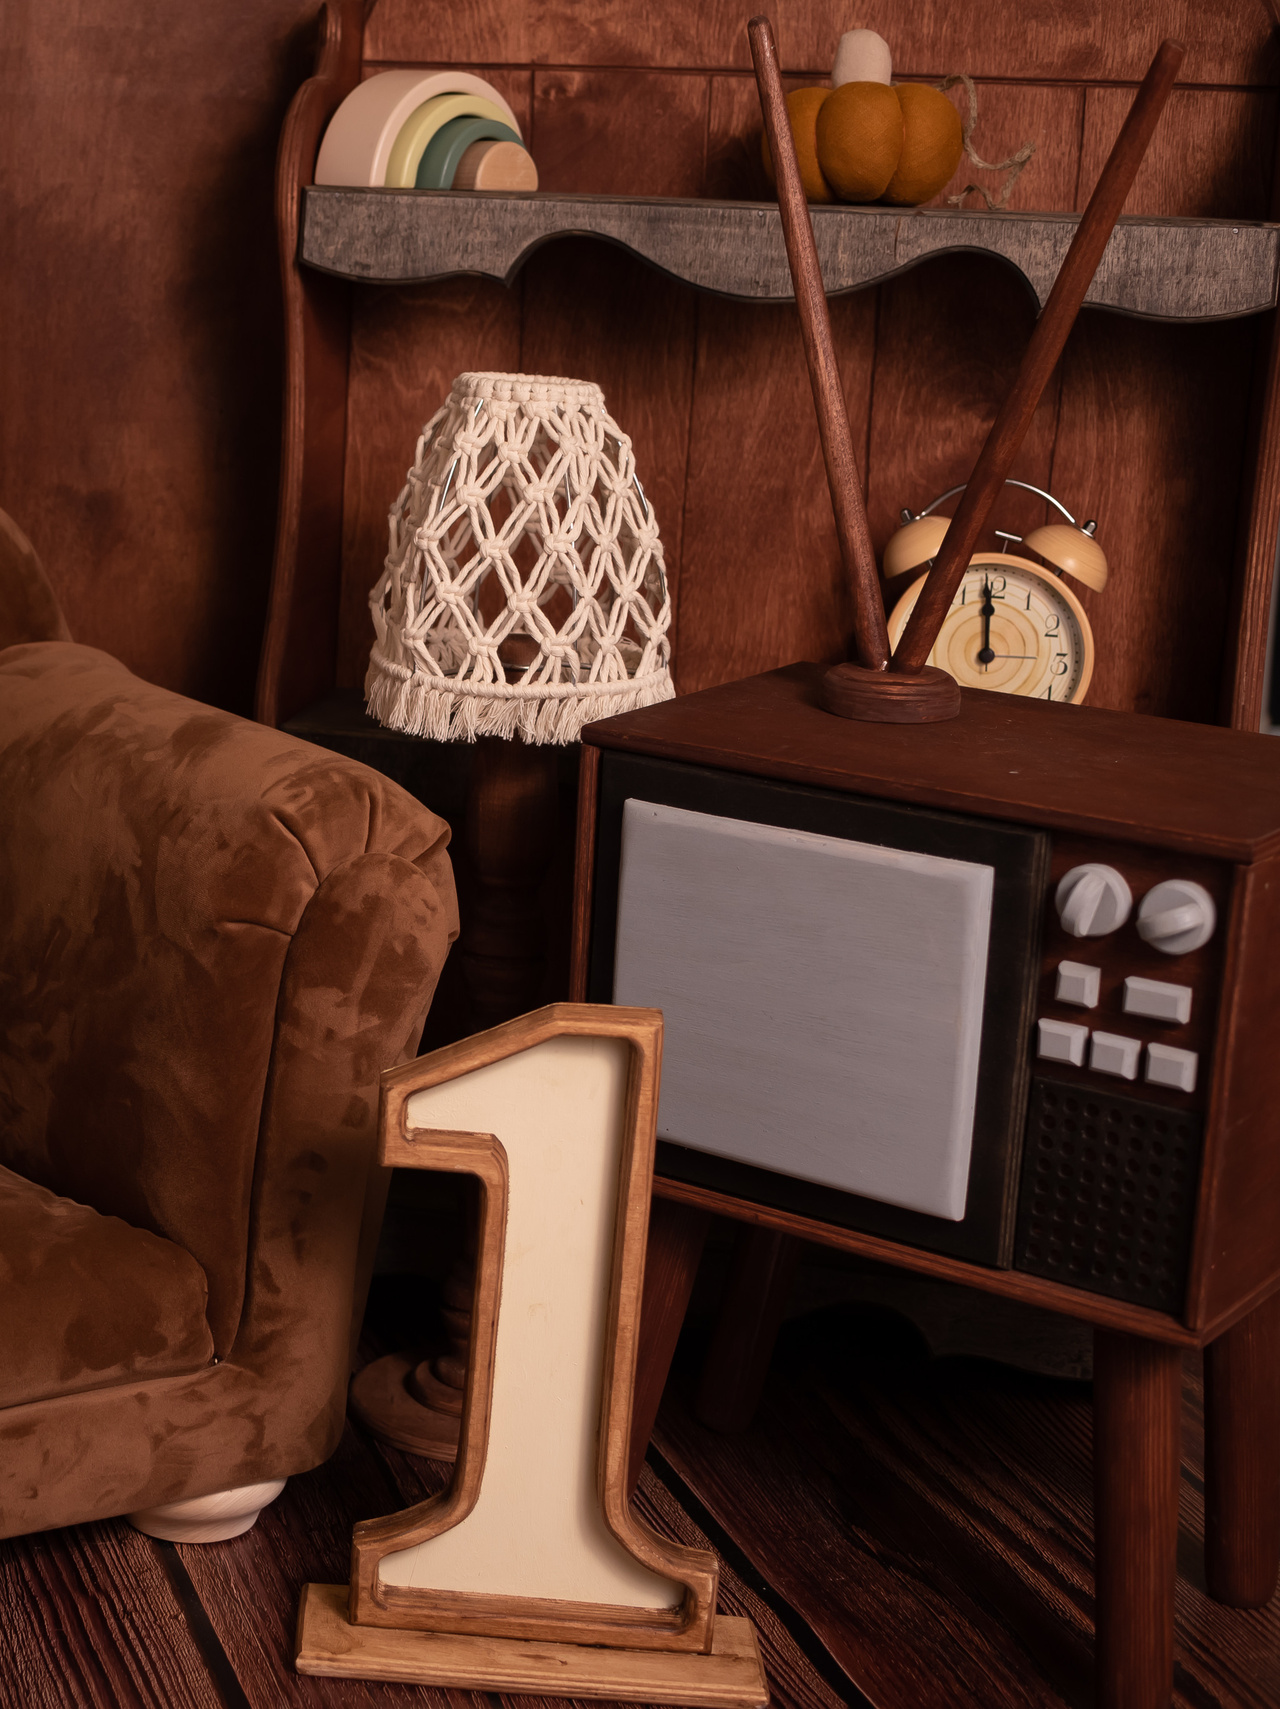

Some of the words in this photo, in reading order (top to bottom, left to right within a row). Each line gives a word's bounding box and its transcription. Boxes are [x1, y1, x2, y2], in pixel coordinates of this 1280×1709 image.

[984, 575, 1006, 600] 2
[1023, 587, 1032, 611] 1
[1044, 613, 1060, 638] 2
[1050, 653, 1069, 676] 3
[349, 1002, 719, 1655] 1
